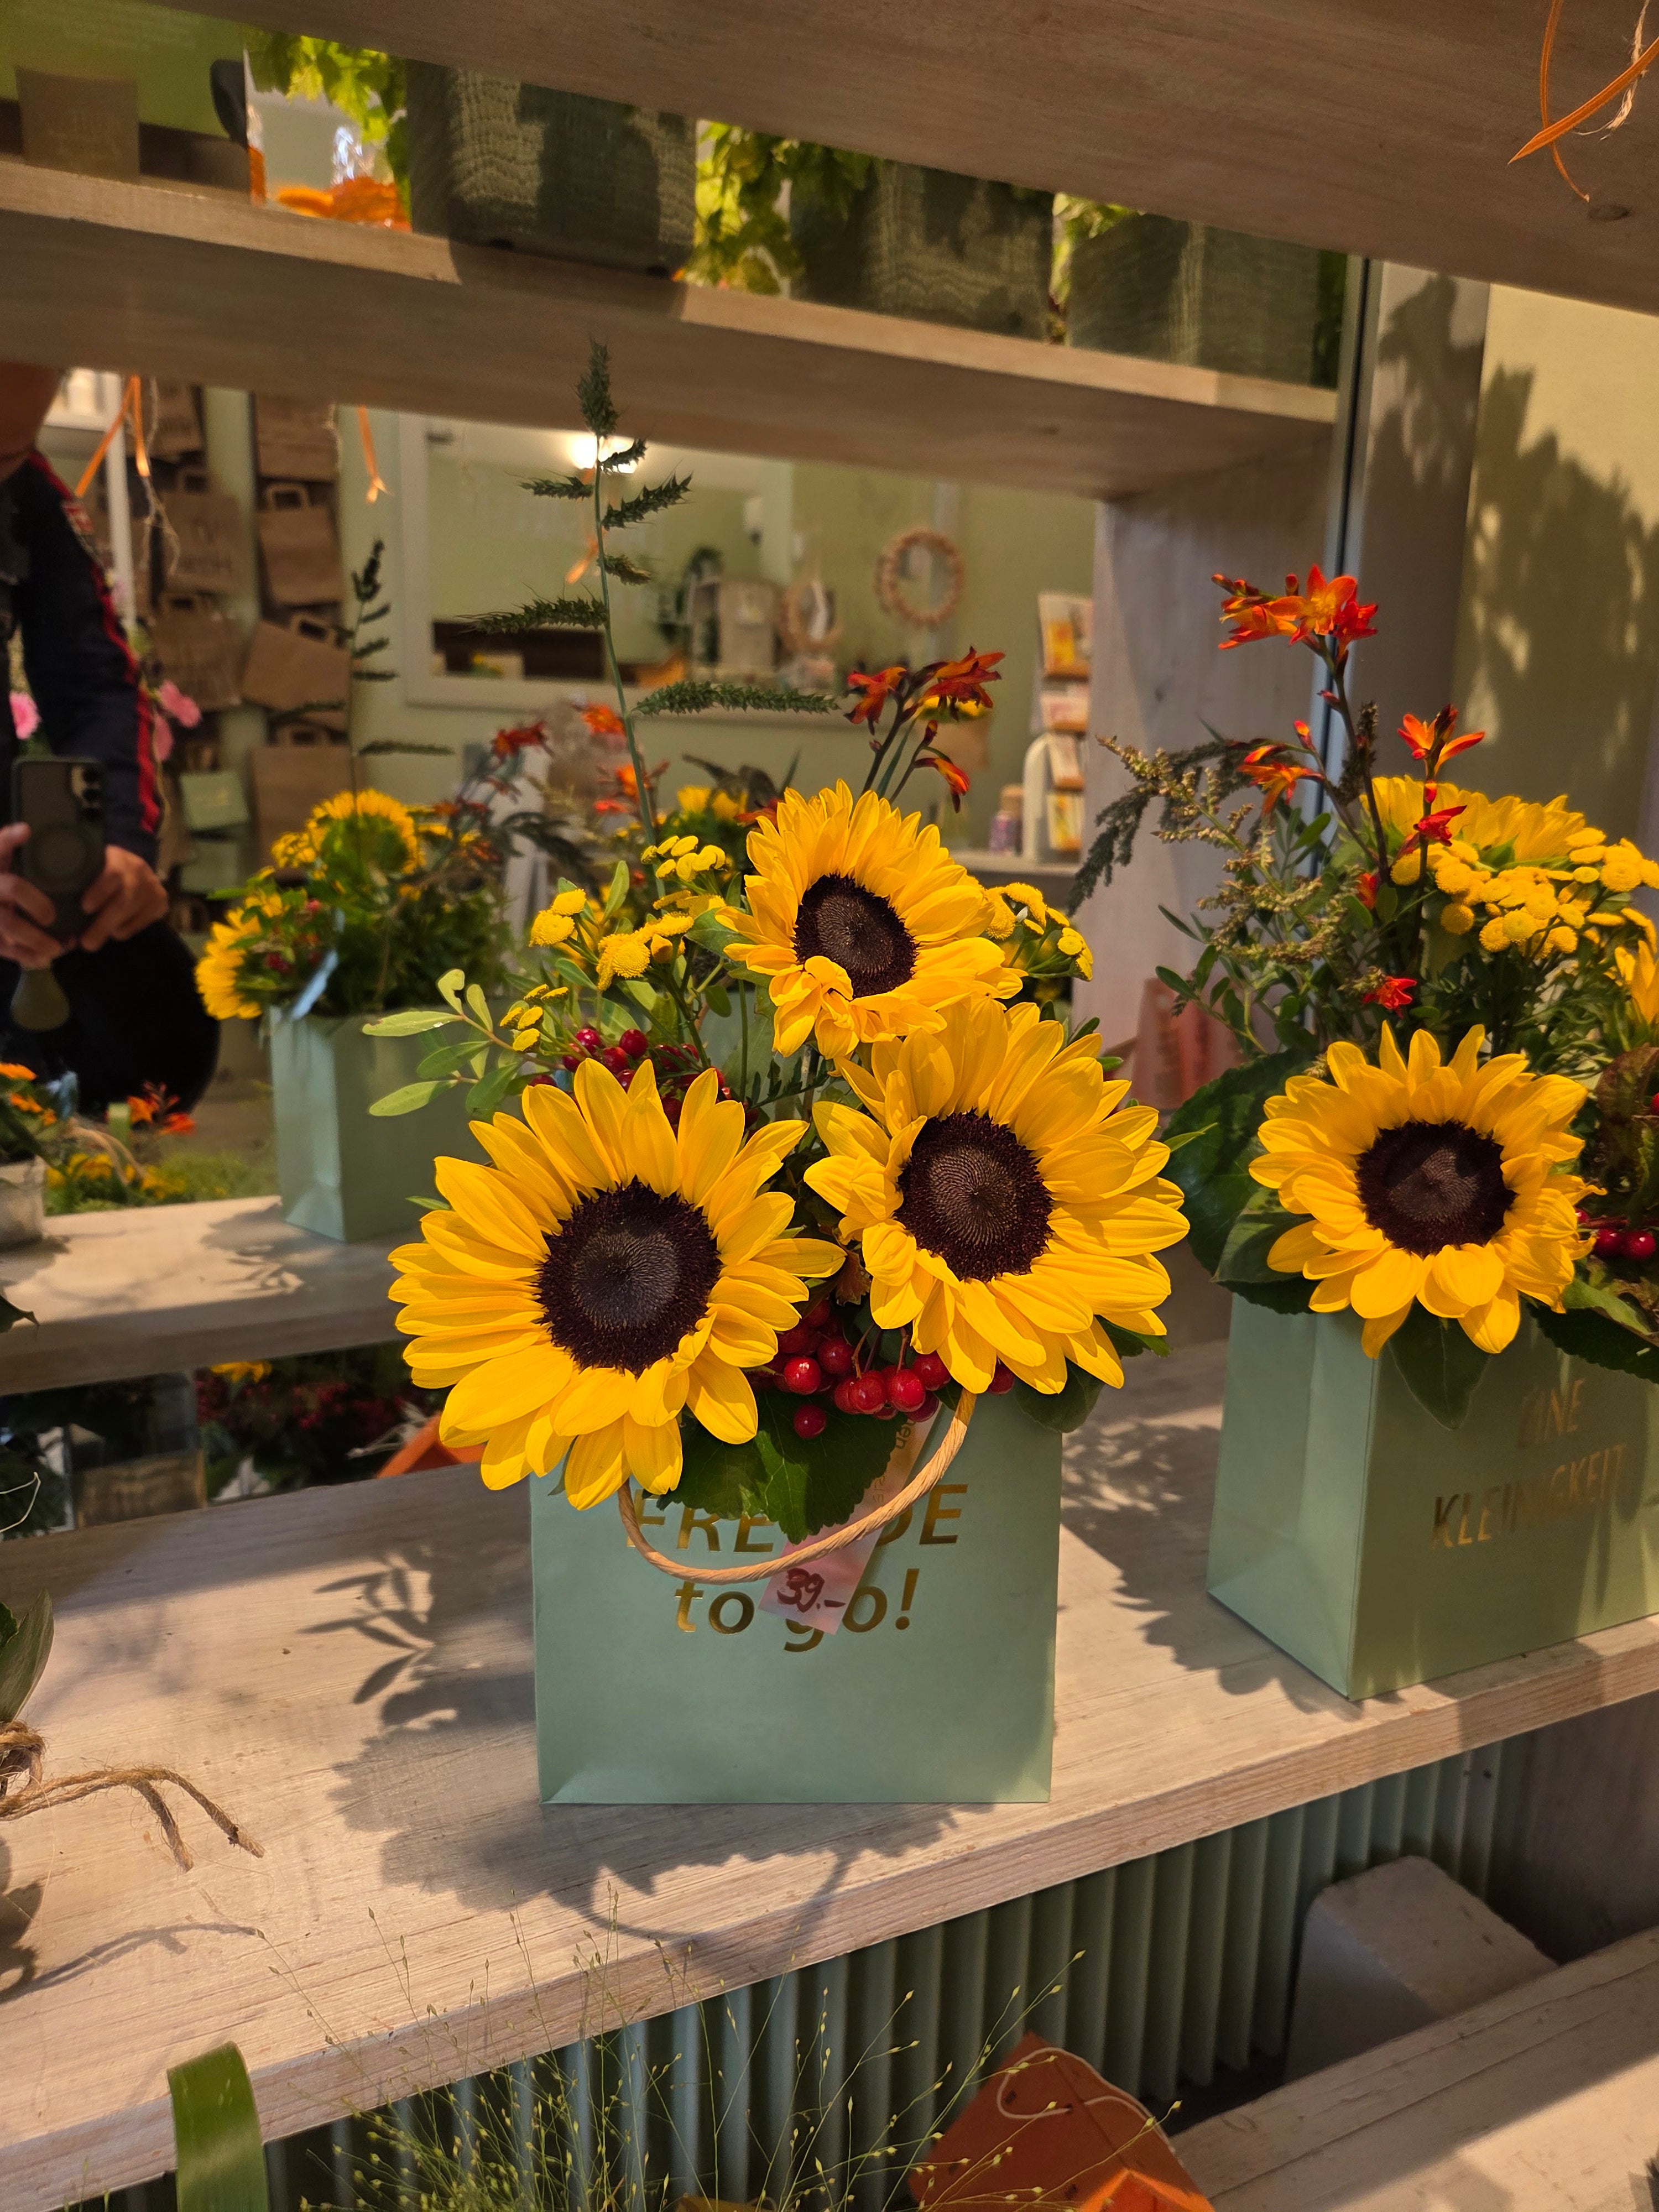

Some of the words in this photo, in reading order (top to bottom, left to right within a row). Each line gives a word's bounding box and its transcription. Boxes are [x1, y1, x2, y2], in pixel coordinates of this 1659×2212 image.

[627, 1484, 968, 1552] FREE
[1430, 1442, 1627, 1550] KLEIGKEIT
[674, 1580, 755, 1635] to
